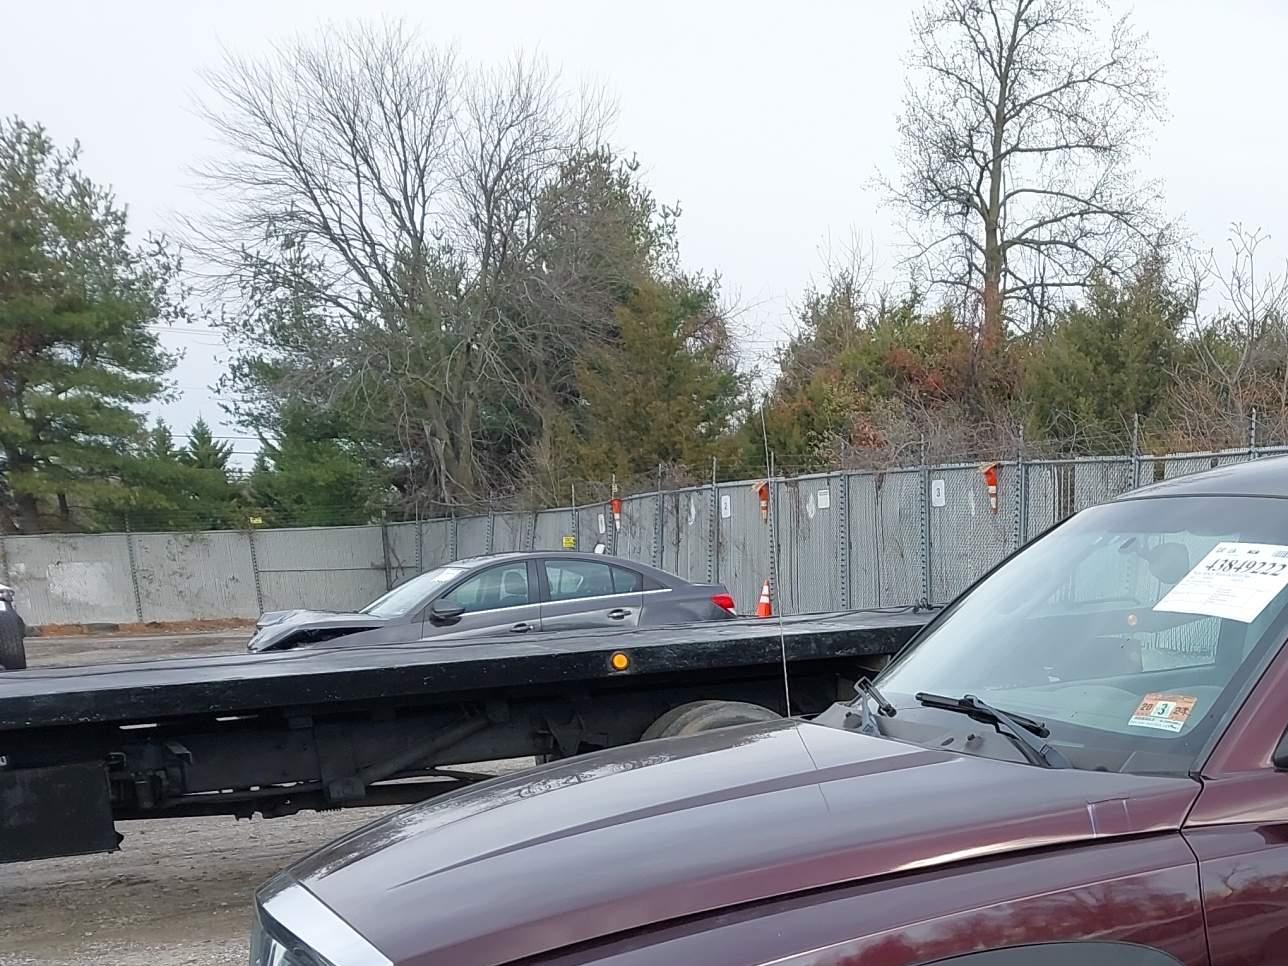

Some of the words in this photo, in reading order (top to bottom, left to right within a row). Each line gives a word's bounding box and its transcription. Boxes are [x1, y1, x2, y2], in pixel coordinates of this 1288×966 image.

[936, 487, 941, 498] 3
[1205, 558, 1287, 577] 43849222
[1157, 703, 1168, 715] 3
